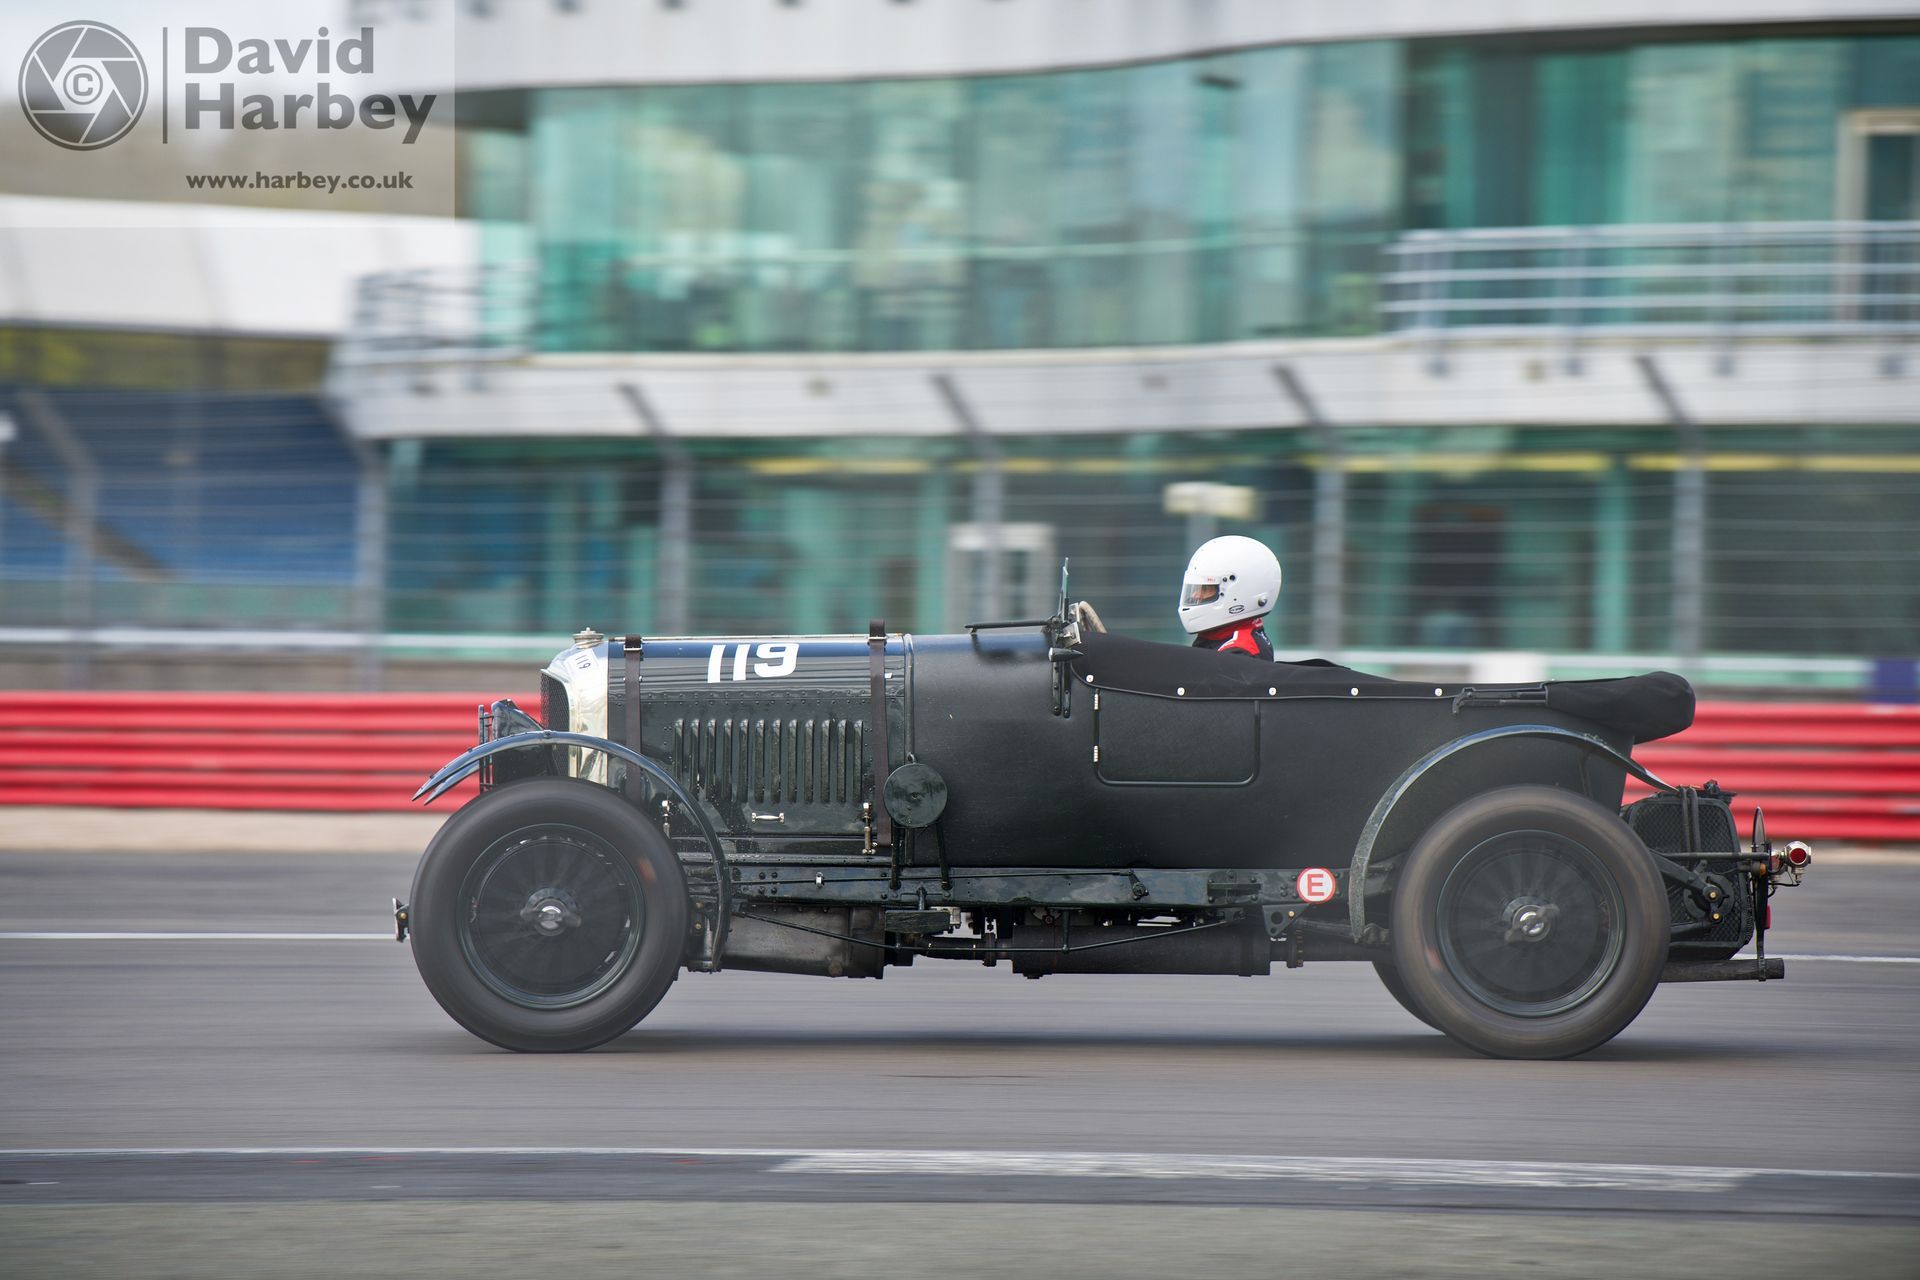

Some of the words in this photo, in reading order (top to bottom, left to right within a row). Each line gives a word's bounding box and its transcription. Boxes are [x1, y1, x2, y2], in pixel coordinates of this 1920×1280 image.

[575, 654, 591, 669] 119
[707, 643, 799, 683] 119
[1307, 873, 1325, 896] E
